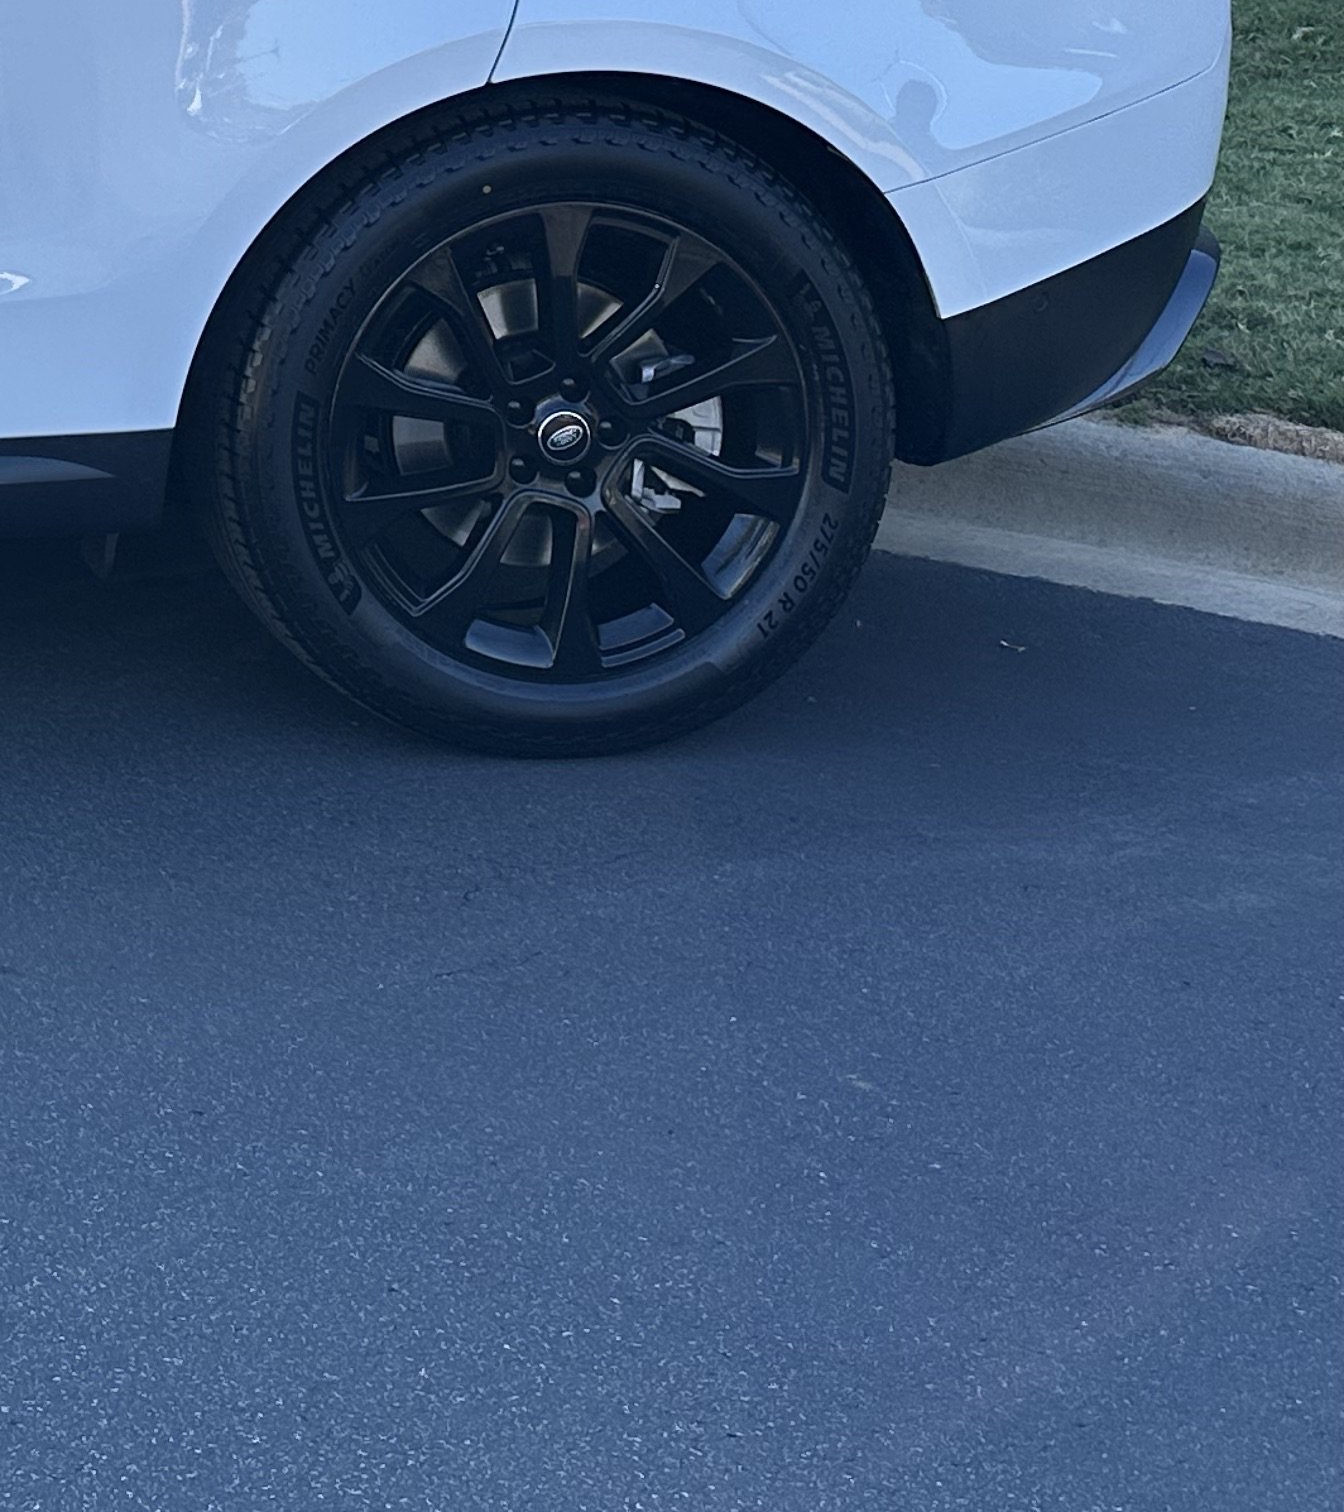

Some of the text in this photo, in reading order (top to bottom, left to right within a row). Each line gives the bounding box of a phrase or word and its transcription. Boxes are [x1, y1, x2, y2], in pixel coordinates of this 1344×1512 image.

[298, 277, 358, 561] MICHELIN PRIMACY
[755, 325, 851, 638] MICHELIN 275/50 R 21
